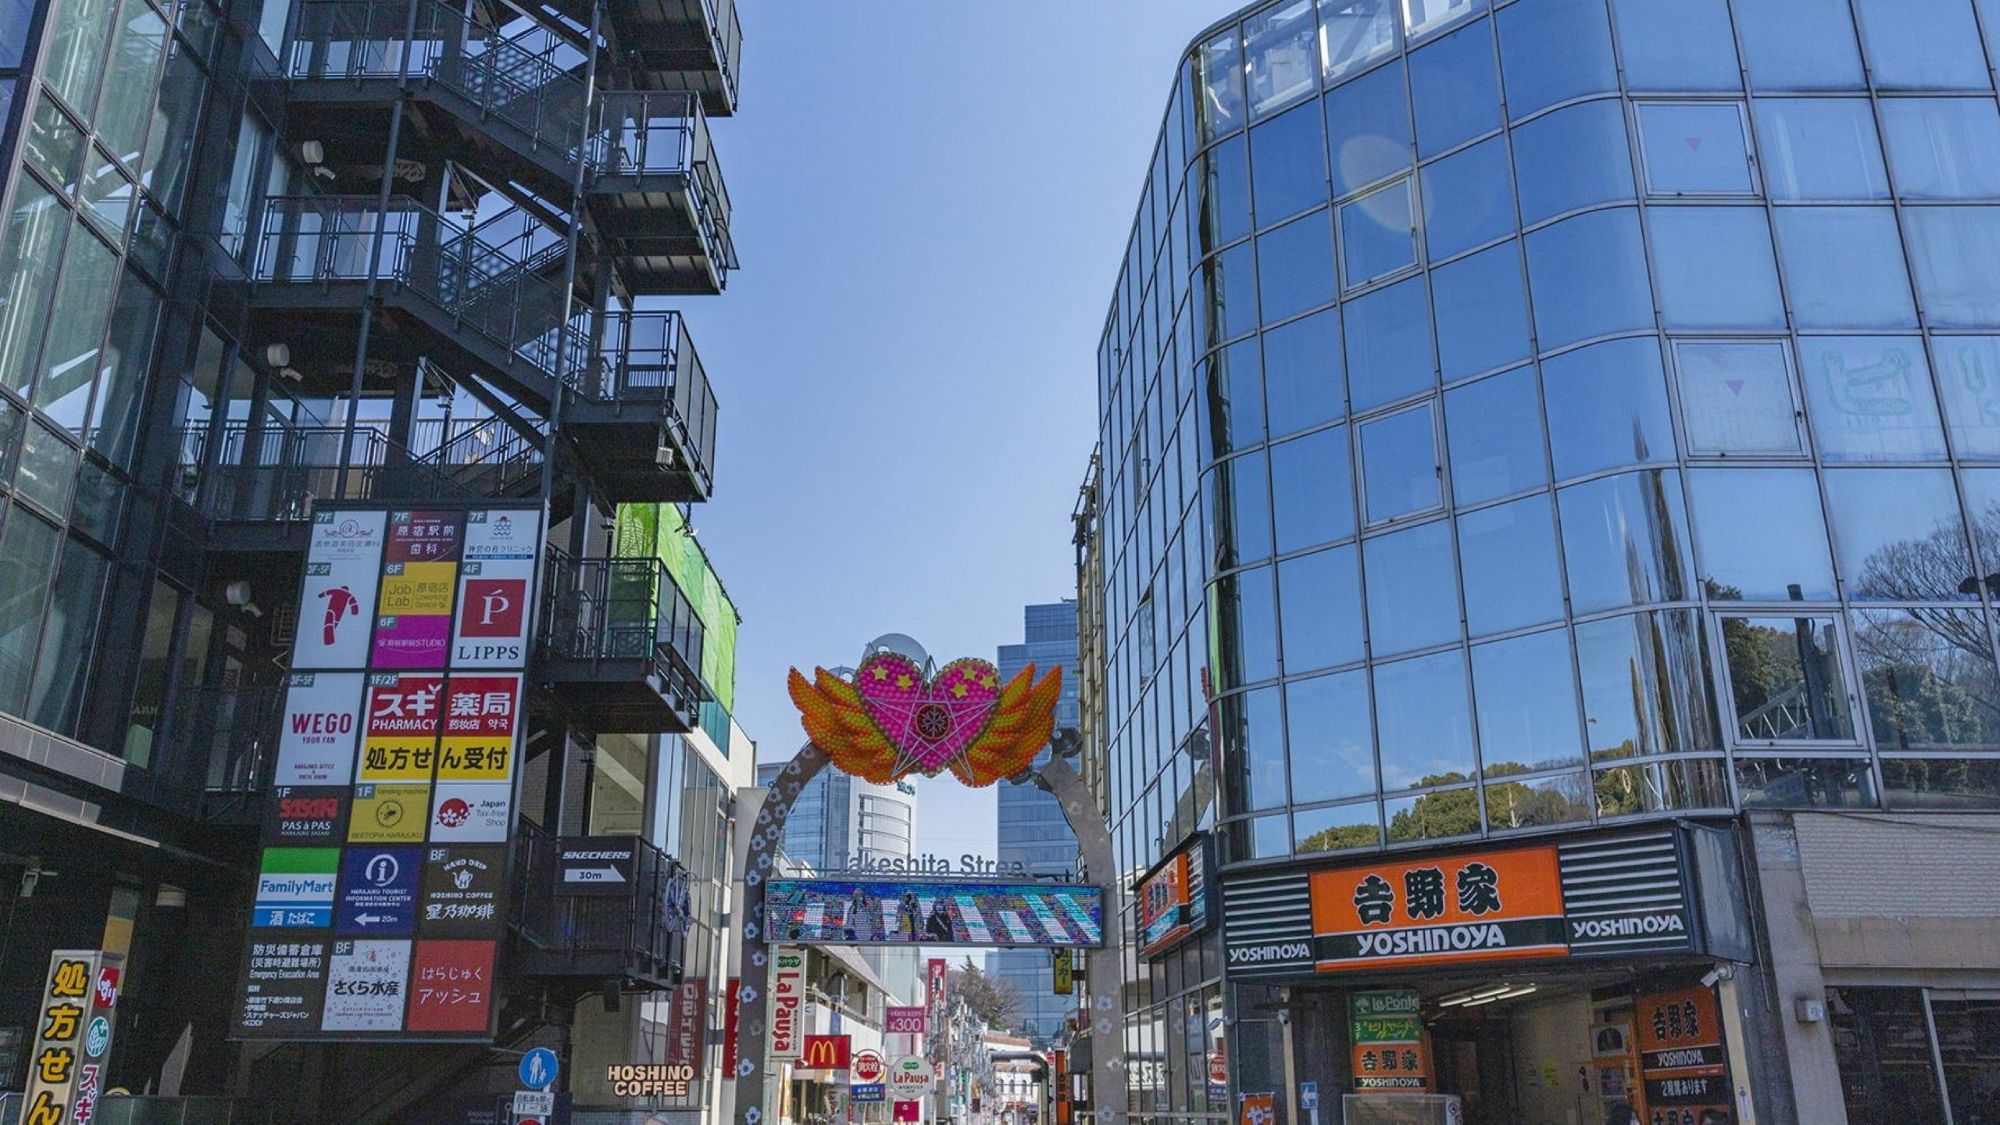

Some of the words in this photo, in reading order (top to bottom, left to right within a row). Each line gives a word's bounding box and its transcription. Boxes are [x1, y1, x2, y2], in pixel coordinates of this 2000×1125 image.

[318, 513, 332, 522] 7F
[395, 512, 409, 522] 7F
[470, 512, 485, 522] 7F
[397, 525, 455, 537] 原宿駅前
[410, 543, 438, 555] 歯科
[386, 564, 402, 574] 6F
[463, 564, 479, 574] 4F
[388, 583, 411, 595] Job
[387, 596, 410, 607] Lab
[380, 617, 395, 627] 6F
[458, 646, 519, 660] LIPPS
[371, 675, 397, 685] 1F/2F
[292, 713, 352, 734] WEGO
[372, 718, 438, 730] PHARMACY
[302, 736, 320, 744] YOUR
[322, 736, 336, 744] FAN
[365, 746, 508, 770] 処方せん受付
[277, 787, 291, 798] 1F
[358, 787, 373, 797] 1F
[480, 800, 506, 808] Japan
[282, 821, 302, 831] PAS
[311, 821, 331, 831] PAS
[486, 819, 506, 827] Shop
[430, 849, 446, 860] BF
[562, 851, 632, 860] SKECHERS
[443, 859, 467, 872] HAND
[468, 859, 487, 870] DRIP
[579, 871, 602, 880] 30m
[261, 880, 333, 895] FamilyMart
[1353, 861, 1503, 927] 吉野家
[269, 911, 284, 925] 酒
[287, 912, 315, 925] たばこ
[382, 915, 398, 923] 20m
[1572, 914, 1684, 939] YOSHINOYA
[1356, 924, 1506, 956] YOSHINOYA
[336, 943, 351, 953] BF
[1229, 944, 1311, 963] YOSHINOYA
[422, 966, 482, 980] はらじゅく
[97, 968, 117, 1006] くすり
[334, 980, 400, 996] さくら水産
[776, 972, 800, 993] La
[418, 988, 481, 1004] アッシュ
[773, 997, 799, 1052] Pausa
[1653, 1000, 1700, 1041] 吉野家
[26, 960, 90, 1125] 処方せん
[1361, 1050, 1419, 1072] 吉野家
[1658, 1050, 1704, 1066] YOSHINOYA
[607, 1065, 695, 1081] HOSHINO
[893, 1072, 904, 1083] La
[904, 1072, 929, 1084] Pausa
[1362, 1078, 1420, 1087] YOSHINOYA
[614, 1081, 687, 1097] COFFEE
